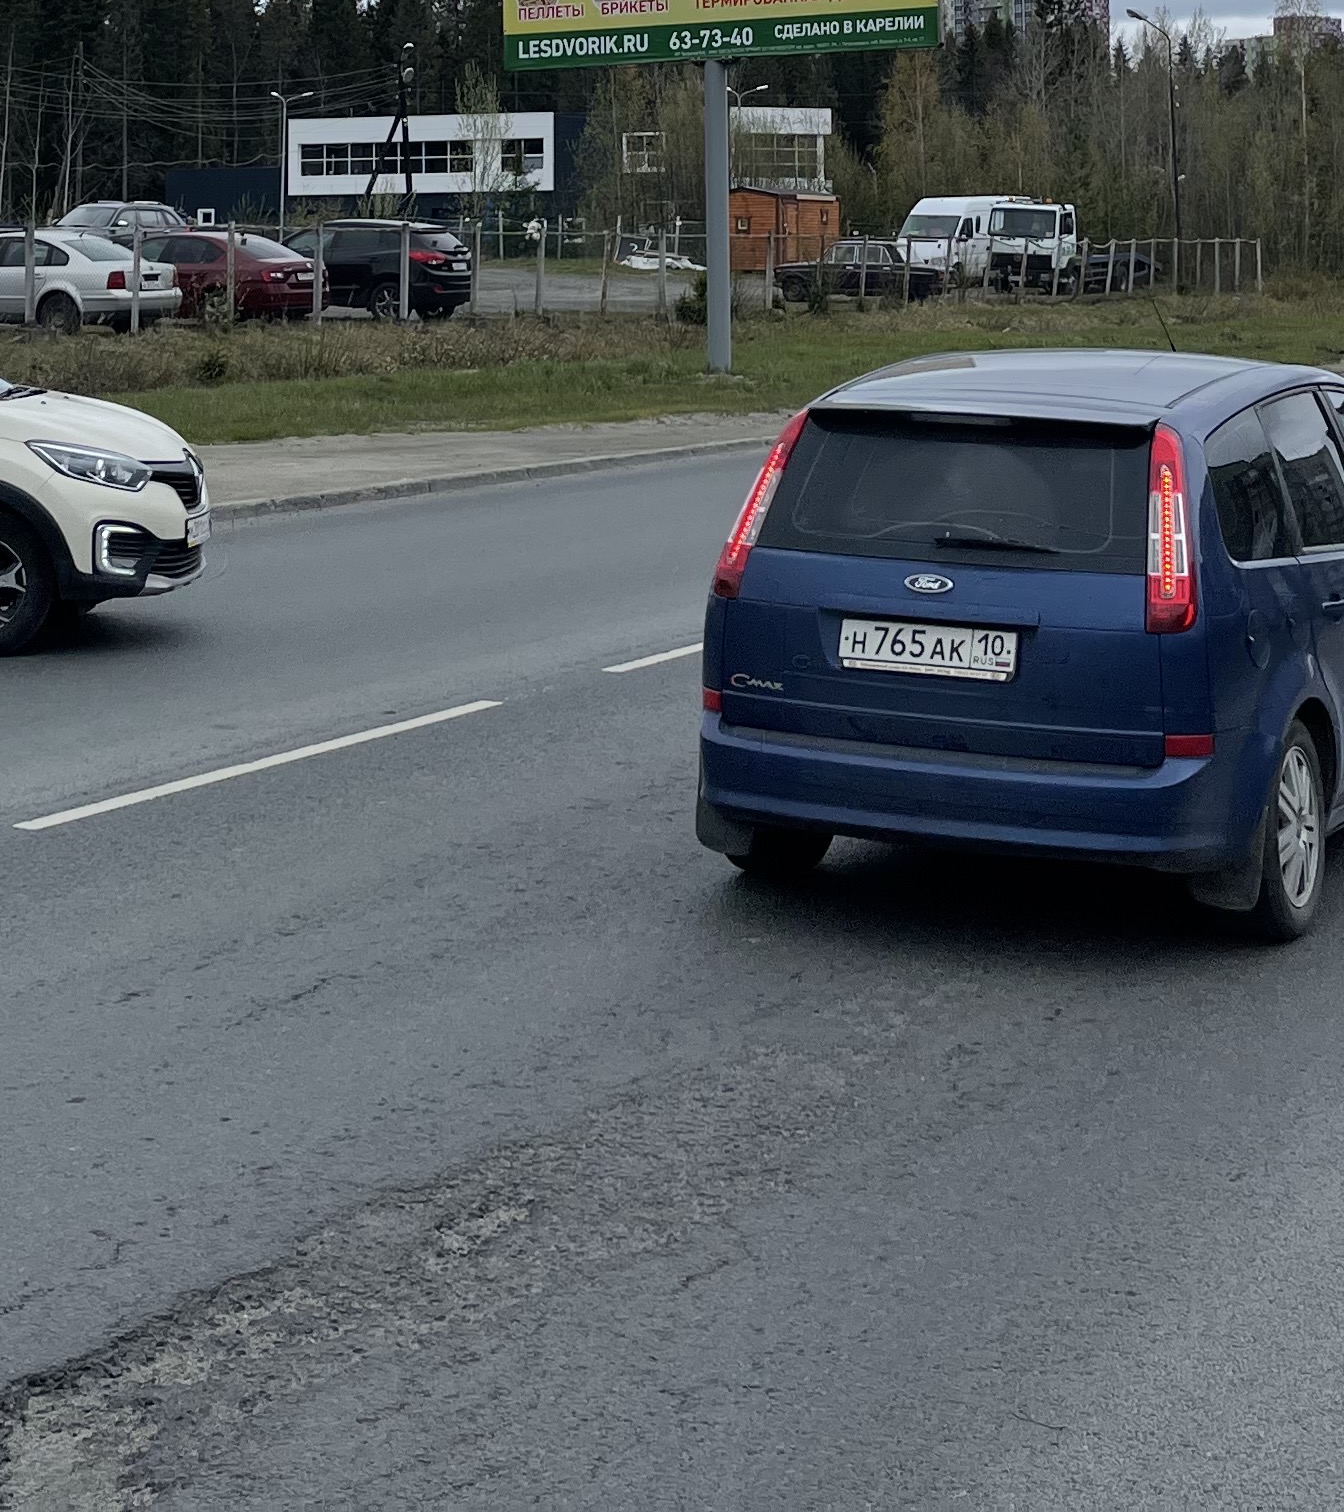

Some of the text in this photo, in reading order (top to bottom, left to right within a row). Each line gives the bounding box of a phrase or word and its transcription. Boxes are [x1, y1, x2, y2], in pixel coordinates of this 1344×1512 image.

[518, 4, 585, 21] ПЕЛЛЕТЫ
[669, 27, 754, 50] 63-73-40
[774, 14, 925, 41] СДЕЛАНО В КАРЕЛИИ
[518, 33, 650, 59] LESDVORIK.RU
[914, 576, 942, 590] Ford
[977, 633, 1005, 656] 10
[972, 656, 994, 666] RUS
